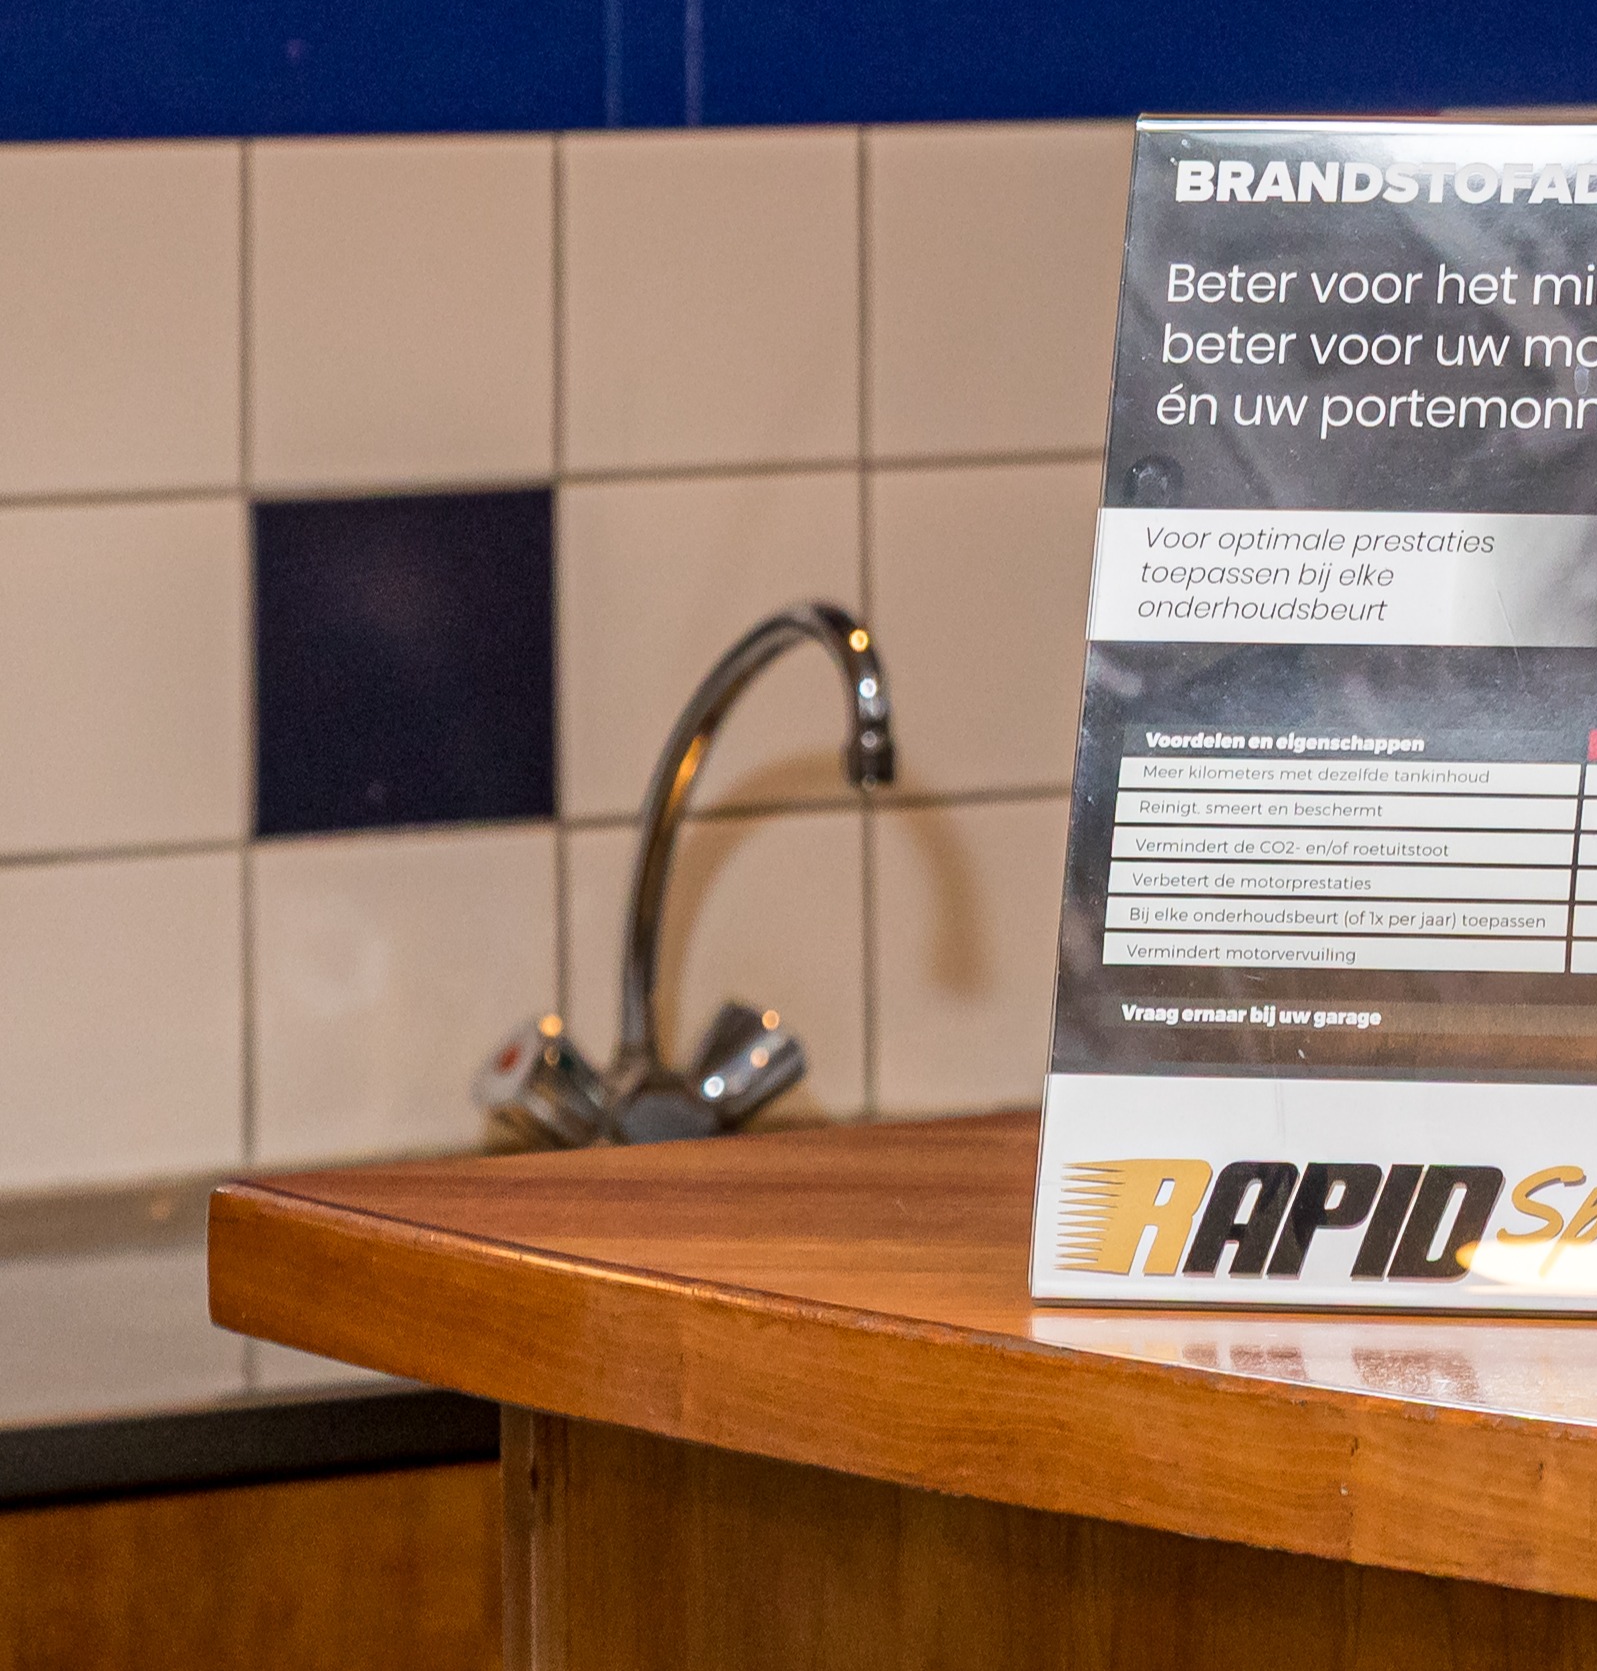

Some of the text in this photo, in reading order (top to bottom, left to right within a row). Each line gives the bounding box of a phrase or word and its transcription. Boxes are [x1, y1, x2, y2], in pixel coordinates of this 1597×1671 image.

[1167, 264, 1297, 304] Beter
[1310, 274, 1417, 306] voor
[1436, 264, 1517, 306] het
[1162, 325, 1297, 367] beter
[1310, 336, 1417, 368] voor
[1436, 338, 1509, 368] uw
[1156, 385, 1217, 426] én
[1233, 397, 1307, 427] uw
[1145, 527, 1495, 558] Voor optimale prestaties
[1141, 562, 1394, 593] toepassen bij elke
[1137, 596, 1388, 622] onderhoudsbeurt
[1145, 731, 1425, 755] Voordelen en eigenschappen
[1143, 764, 1490, 785] Meer kilometers met dezelfde tankinhoud
[1206, 802, 1263, 816] smeert
[1268, 804, 1288, 817] en
[1293, 801, 1383, 818] beschermt
[1134, 837, 1449, 858] Vermindert de CO2- en/of roetuitstoot
[1132, 872, 1372, 893] Verbetert de motorprestaties
[1129, 907, 1150, 924] Bij
[1154, 908, 1188, 923] elke
[1193, 909, 1339, 925] onderhoudsbeurt
[1344, 909, 1367, 927] (of
[1388, 914, 1416, 929] per
[1419, 911, 1456, 930] jaar)
[1461, 913, 1546, 930] toepassen
[1127, 944, 1356, 964] Vermindert motorvervuiling
[1122, 1004, 1382, 1029] Vraag ernaar bij uw garage
[1053, 1159, 1507, 1283] RAPID
